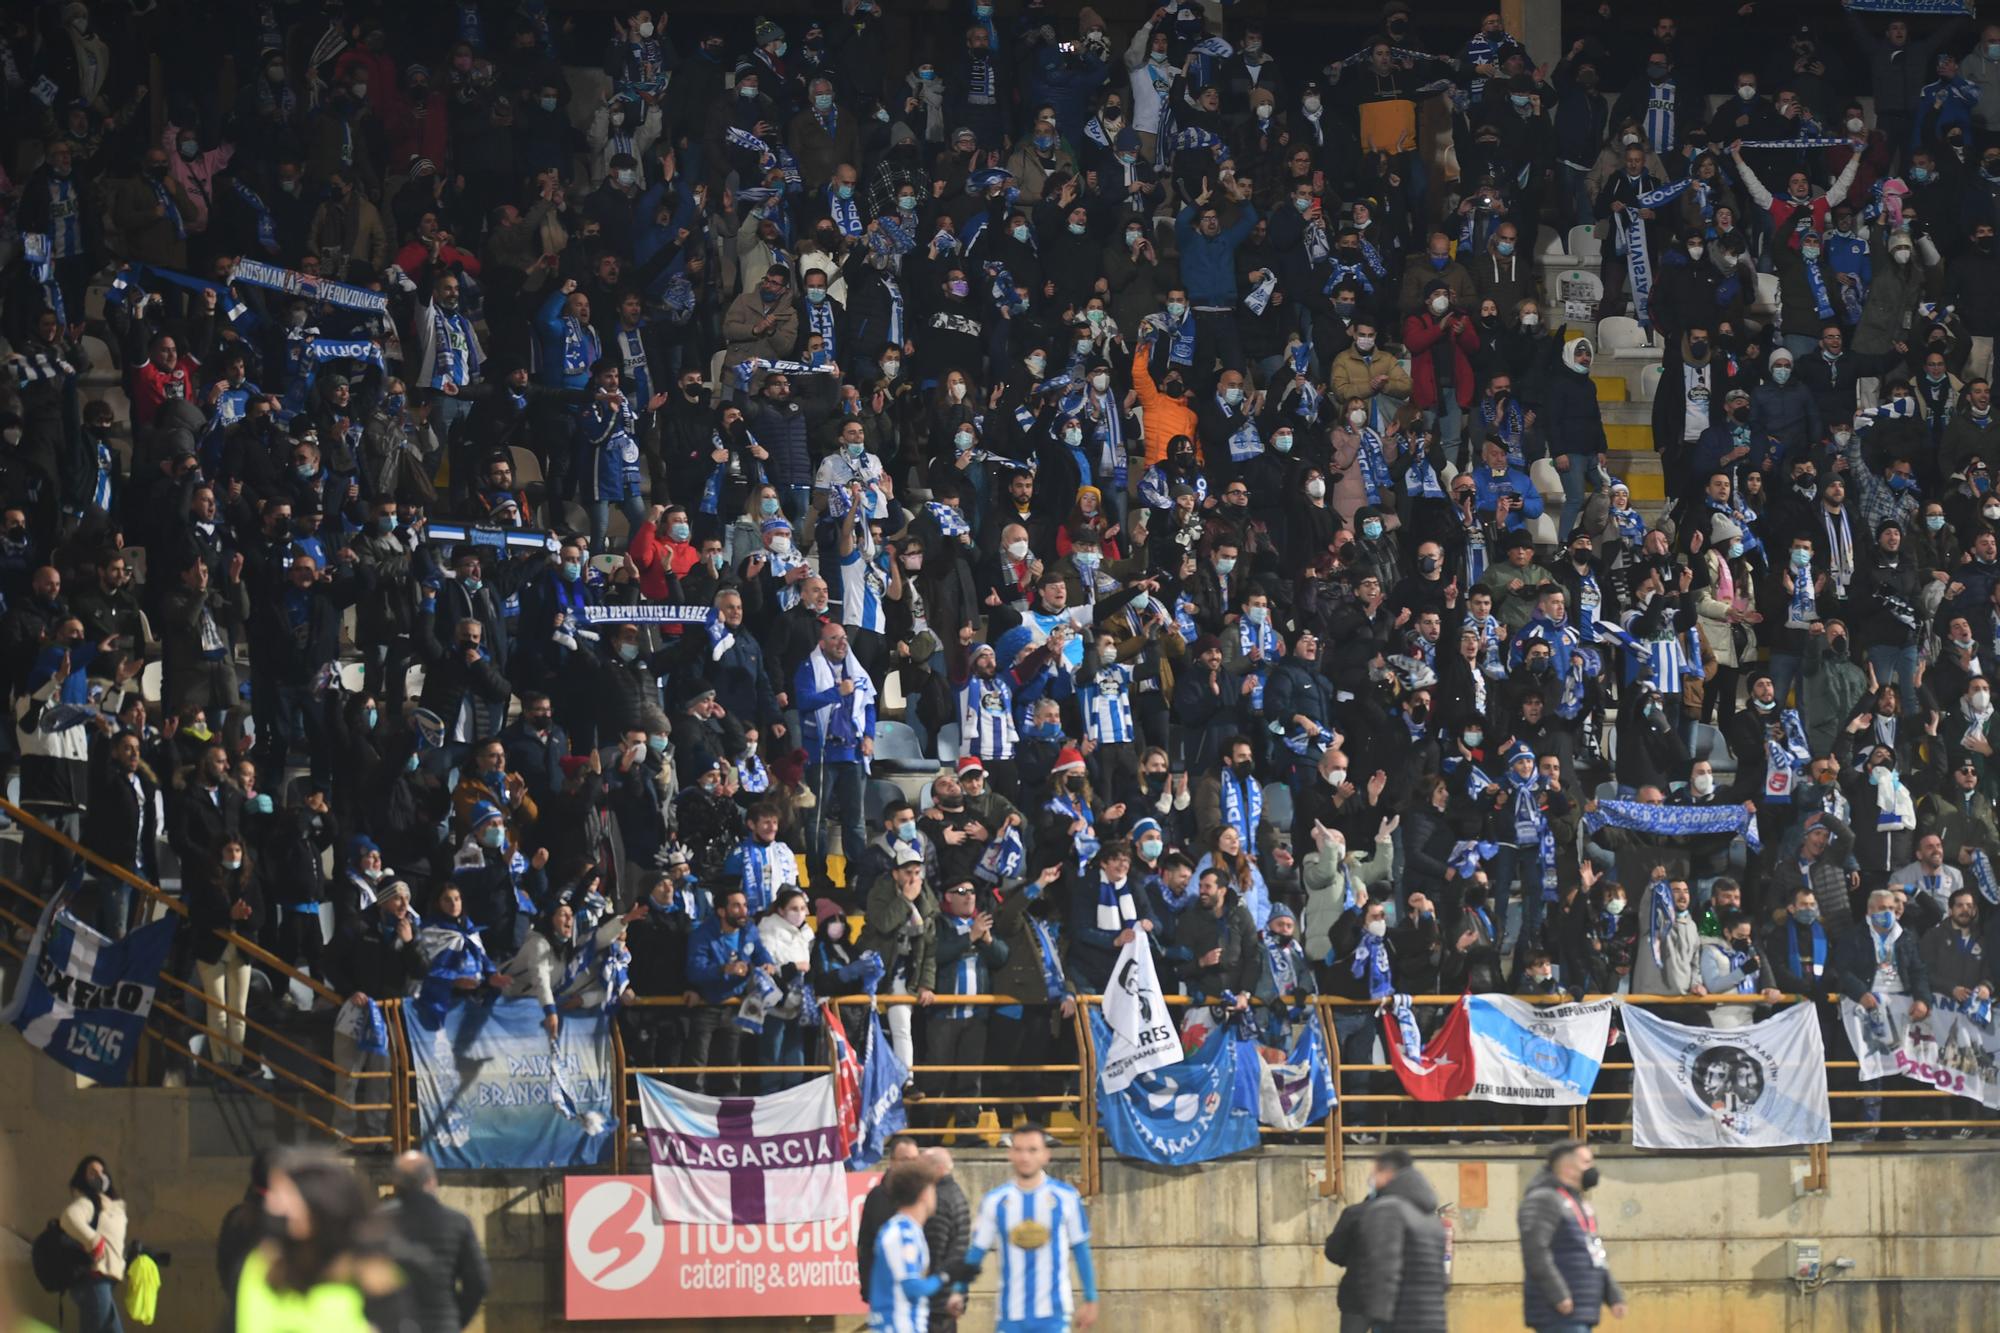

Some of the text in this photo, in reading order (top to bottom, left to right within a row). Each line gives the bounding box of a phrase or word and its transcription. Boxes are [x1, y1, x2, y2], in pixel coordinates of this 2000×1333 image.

[1495, 1085, 1556, 1099] BRANQUIAZUL
[680, 1259, 765, 1294] catering
[767, 1262, 785, 1288] &
